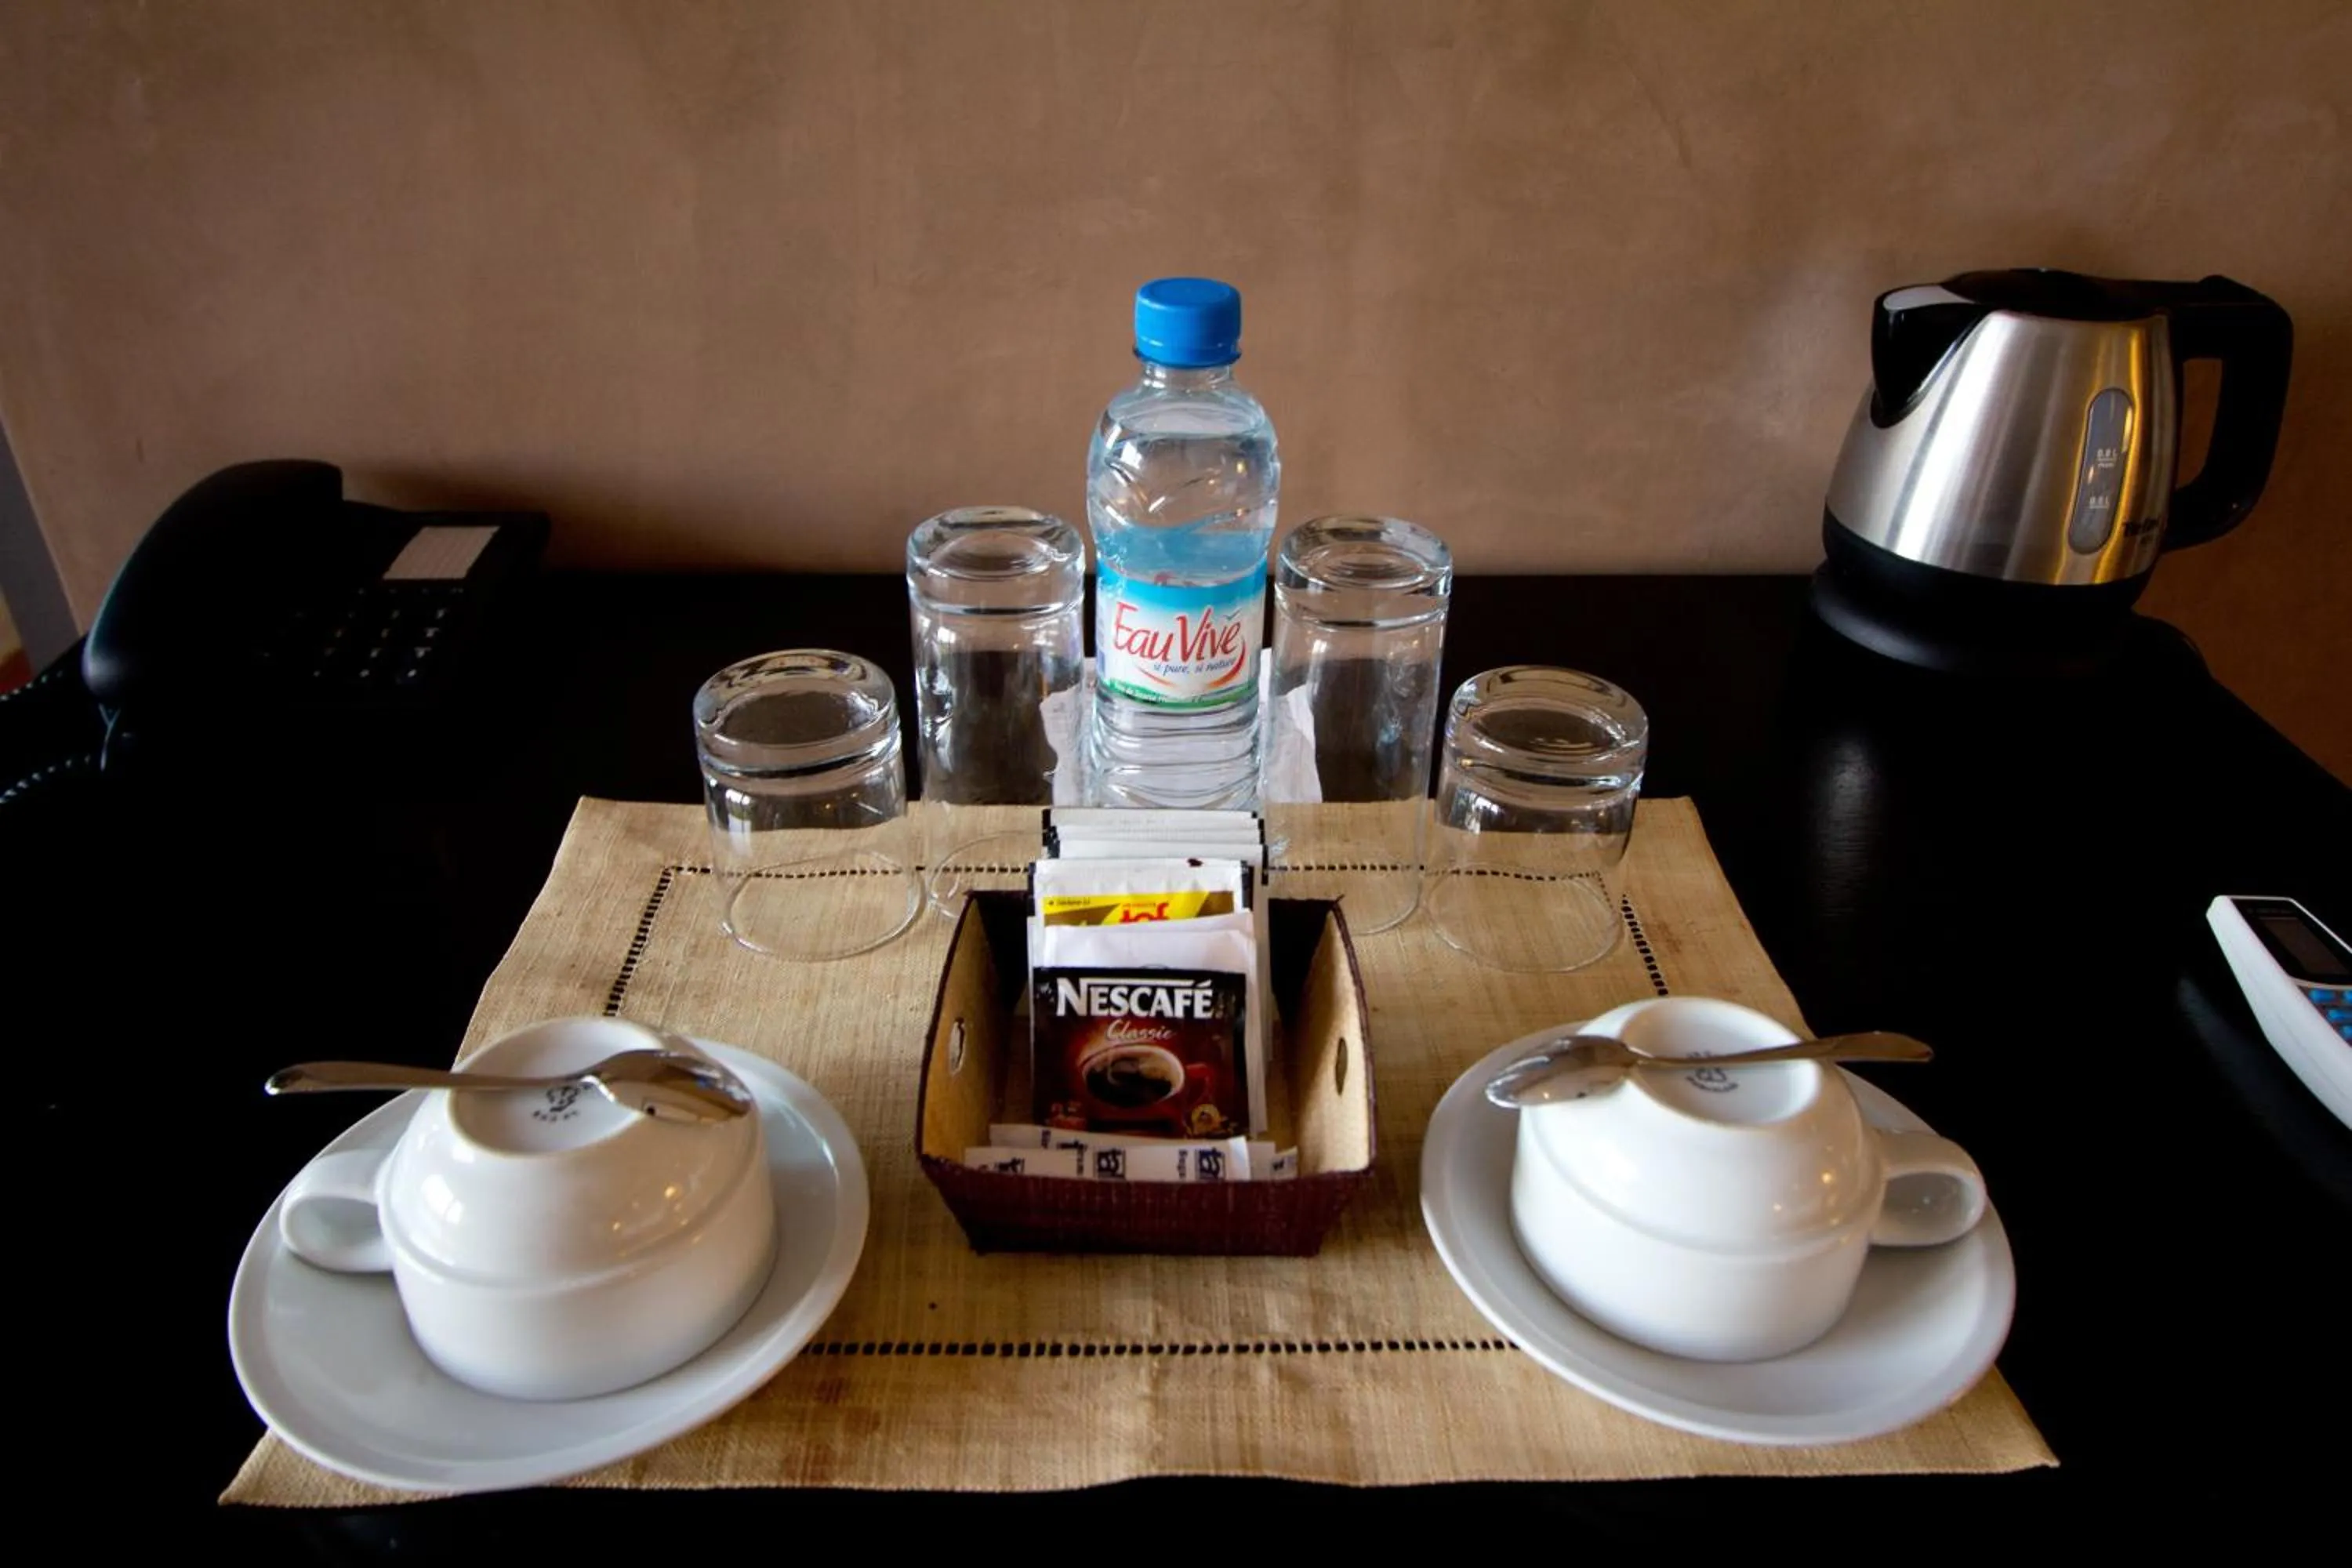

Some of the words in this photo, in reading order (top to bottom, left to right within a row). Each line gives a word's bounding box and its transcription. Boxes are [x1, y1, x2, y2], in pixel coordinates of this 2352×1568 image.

[1113, 602, 1174, 662] Eau
[1056, 978, 1214, 1018] NESCAFÉ
[1105, 1018, 1176, 1041] Classic
